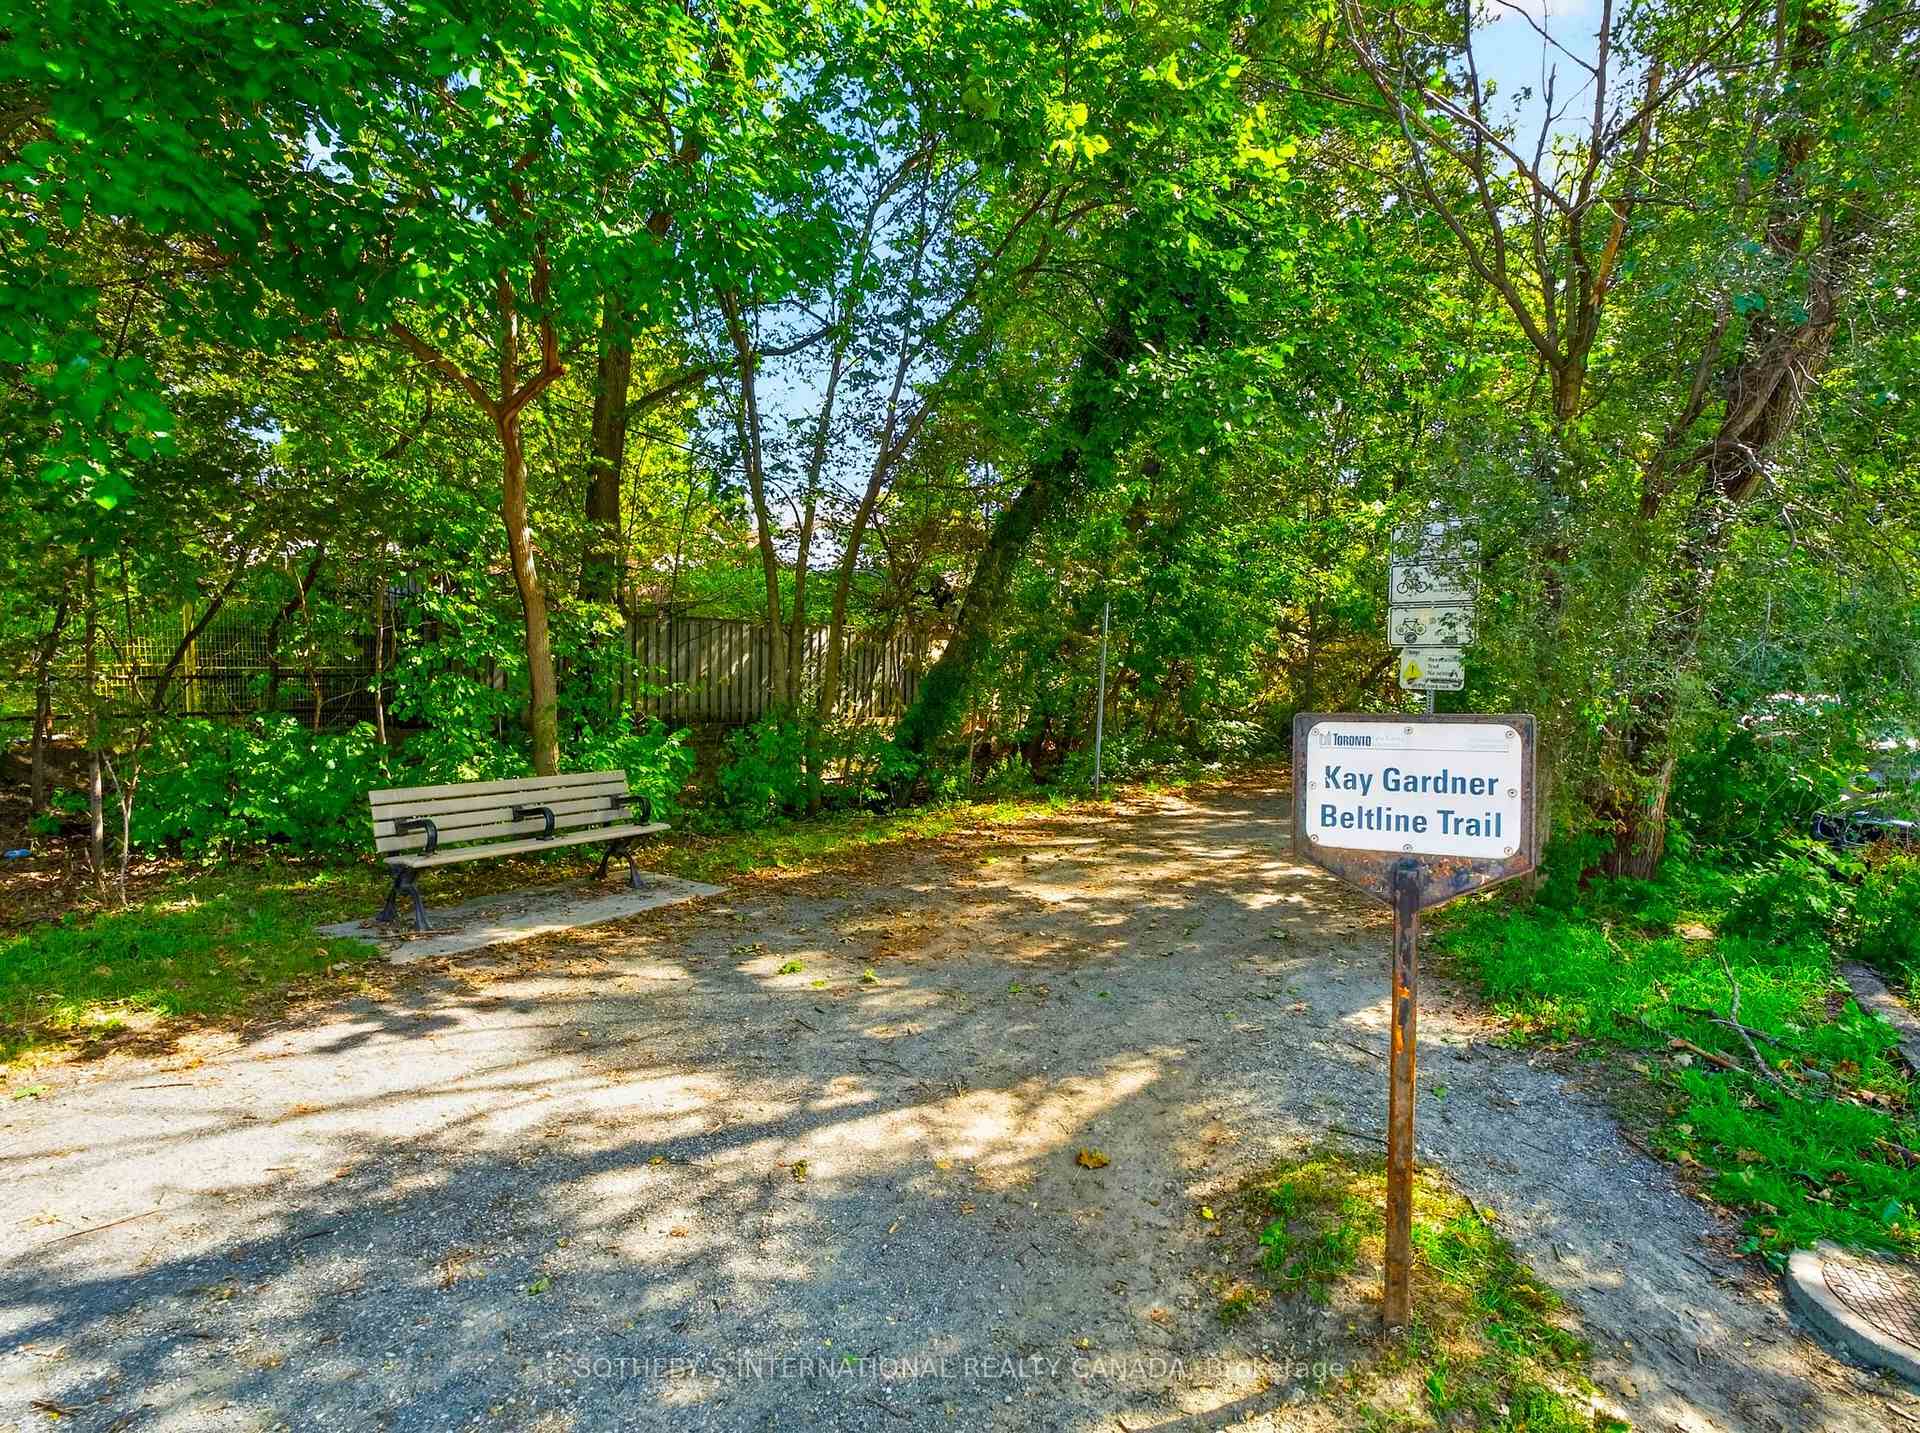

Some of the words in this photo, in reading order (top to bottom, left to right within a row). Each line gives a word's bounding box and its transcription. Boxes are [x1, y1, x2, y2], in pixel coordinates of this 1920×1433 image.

[1333, 733, 1372, 747] TORONTO
[1325, 764, 1373, 797] Kay
[1382, 767, 1499, 796] Gardner
[1320, 803, 1428, 834] Beltline
[1437, 809, 1502, 838] Trail
